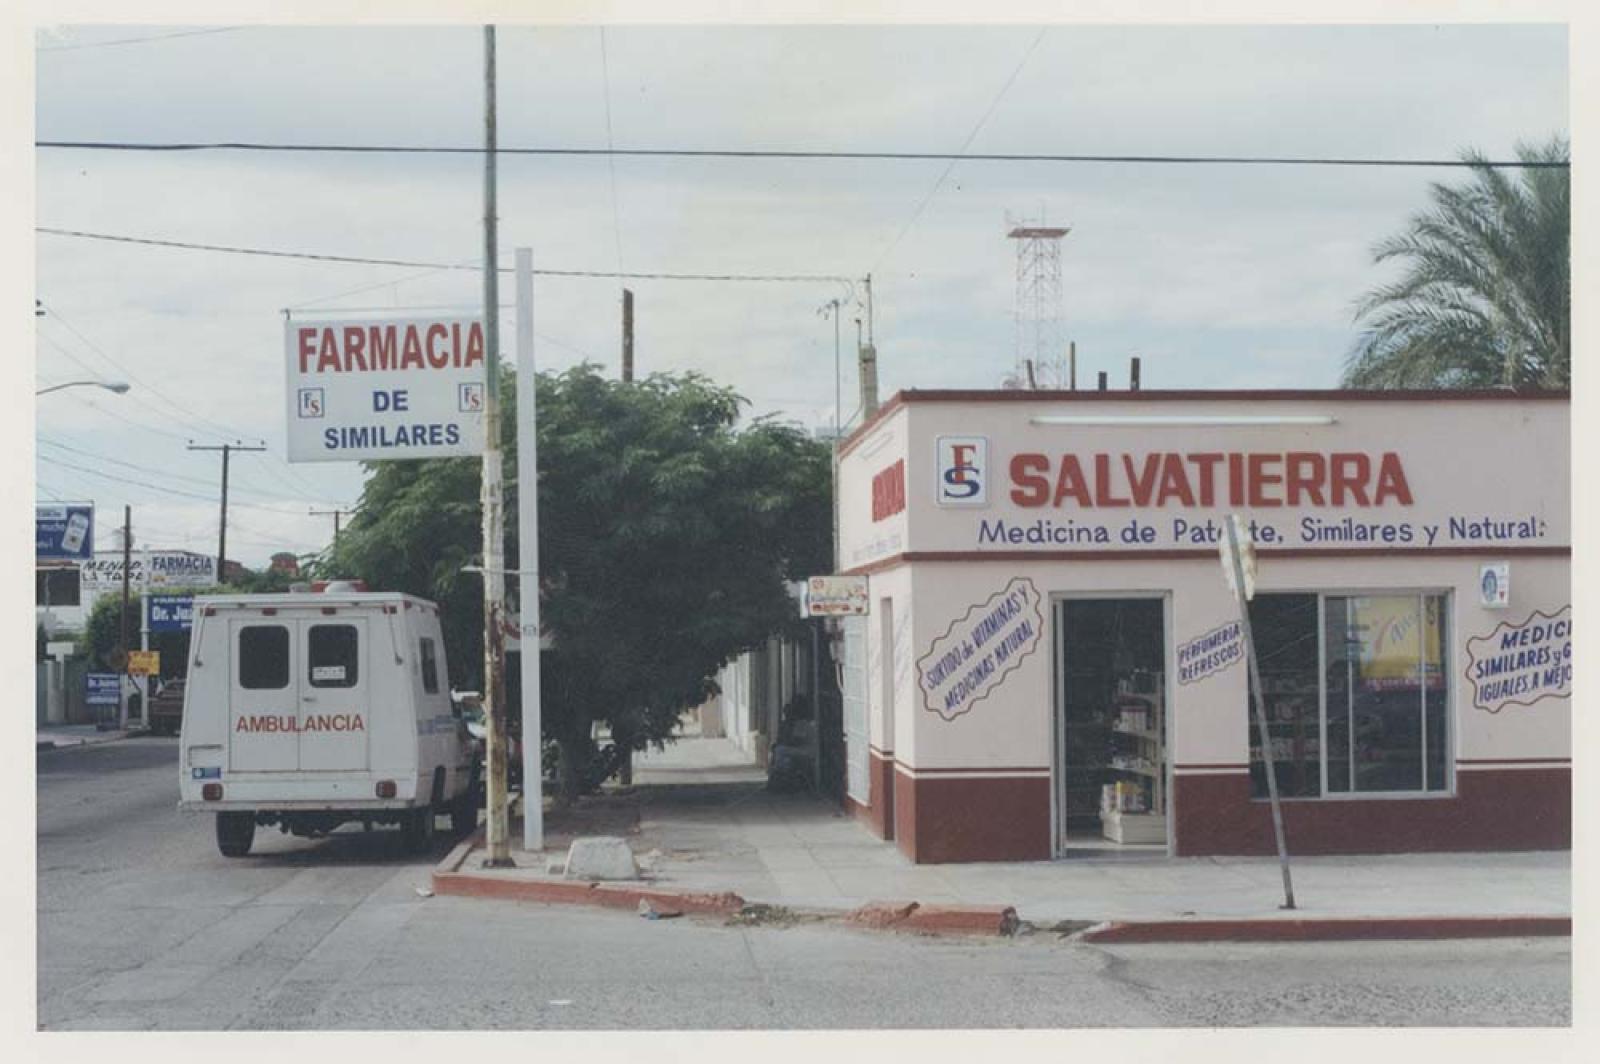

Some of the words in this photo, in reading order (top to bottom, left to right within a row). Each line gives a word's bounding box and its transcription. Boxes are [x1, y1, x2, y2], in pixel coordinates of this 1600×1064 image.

[298, 321, 484, 373] FARMACIA
[373, 390, 409, 412] DE
[324, 423, 460, 450] SIMILARES
[1009, 452, 1414, 509] SALVATIERRA
[979, 519, 1110, 544] Medicina
[1120, 520, 1156, 543] de
[1173, 518, 1284, 545] Patte,
[1301, 516, 1413, 543] Similares
[1423, 524, 1439, 546] y
[152, 556, 212, 572] FARMACIA
[944, 653, 996, 711] MEDICINAS
[995, 618, 1034, 665] NATURAL
[1180, 641, 1240, 681] REFRESCOS
[1476, 645, 1550, 680] SIMILARES
[236, 714, 365, 733] AMBULANCIA
